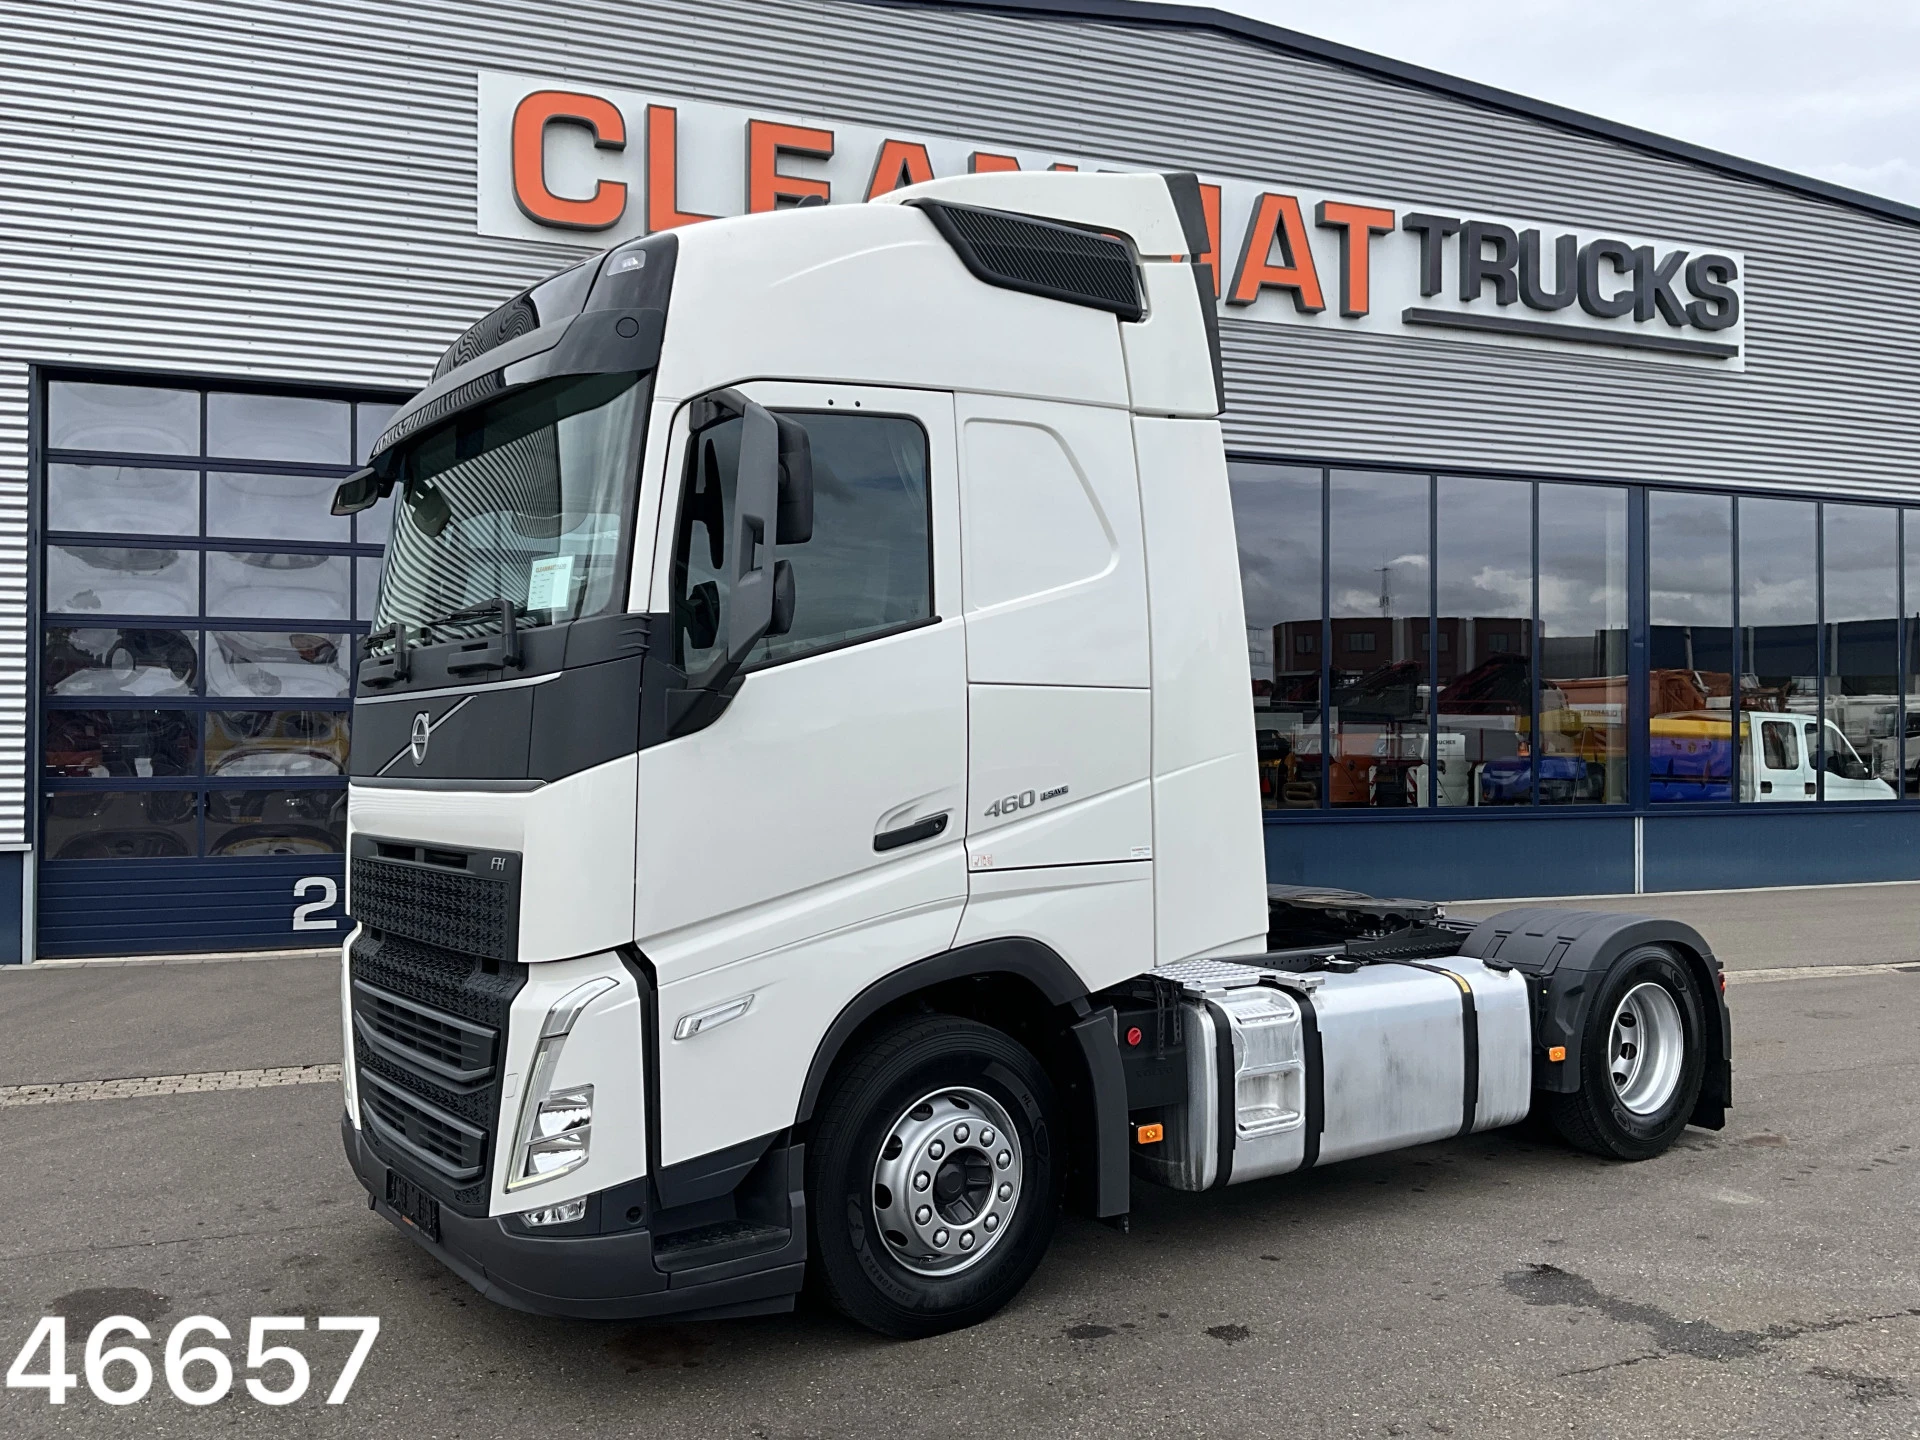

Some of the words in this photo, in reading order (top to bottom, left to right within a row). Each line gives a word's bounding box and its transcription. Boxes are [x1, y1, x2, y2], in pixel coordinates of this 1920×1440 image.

[512, 90, 1395, 319] CLEAT
[1403, 211, 1738, 332] TRUCKS
[984, 789, 1036, 817] 460
[490, 856, 506, 871] FH
[293, 876, 337, 931] 2
